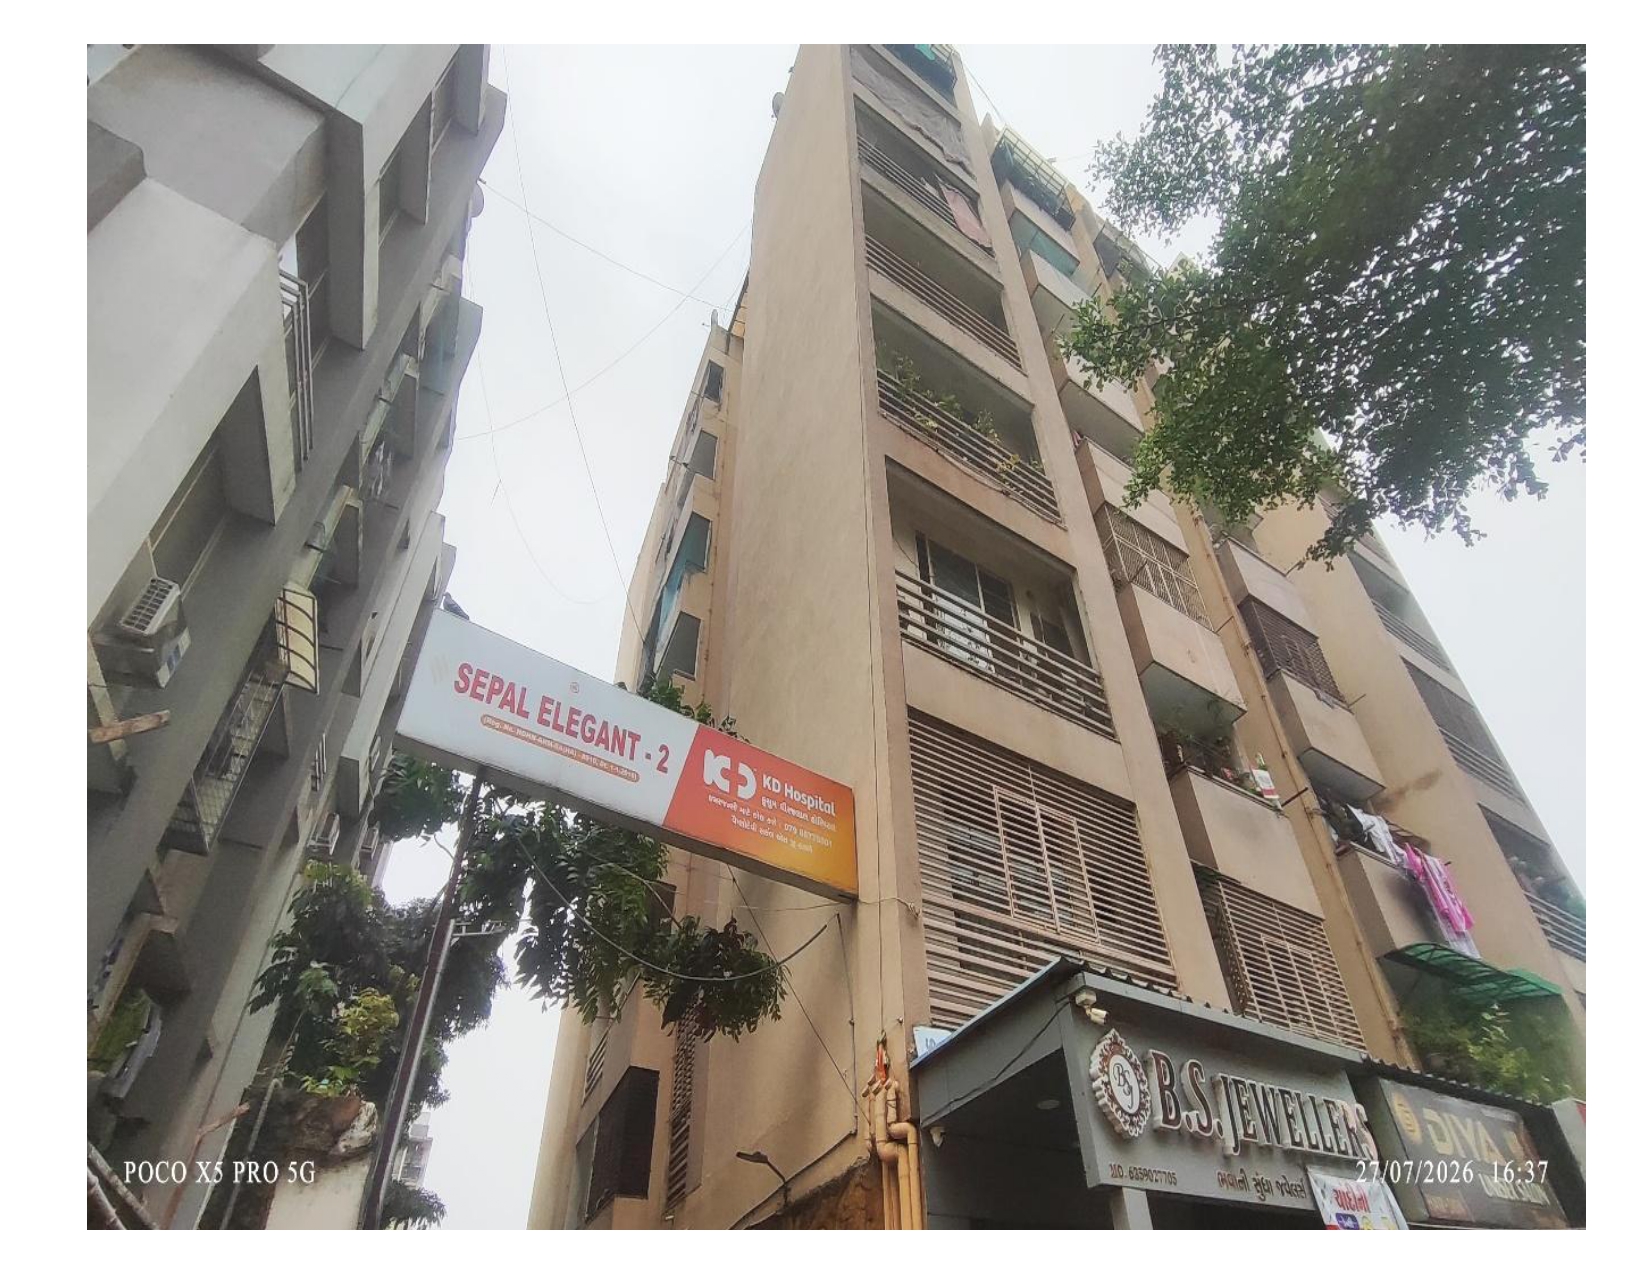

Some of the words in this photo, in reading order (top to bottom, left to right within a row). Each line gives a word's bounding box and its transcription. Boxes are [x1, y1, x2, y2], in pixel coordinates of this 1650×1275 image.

[454, 662, 530, 720] SEPAL
[536, 694, 642, 761] ELEGANT
[656, 743, 670, 774] 2
[762, 774, 781, 793] KD
[784, 782, 836, 817] Hospital
[1422, 1107, 1507, 1167] DIYA
